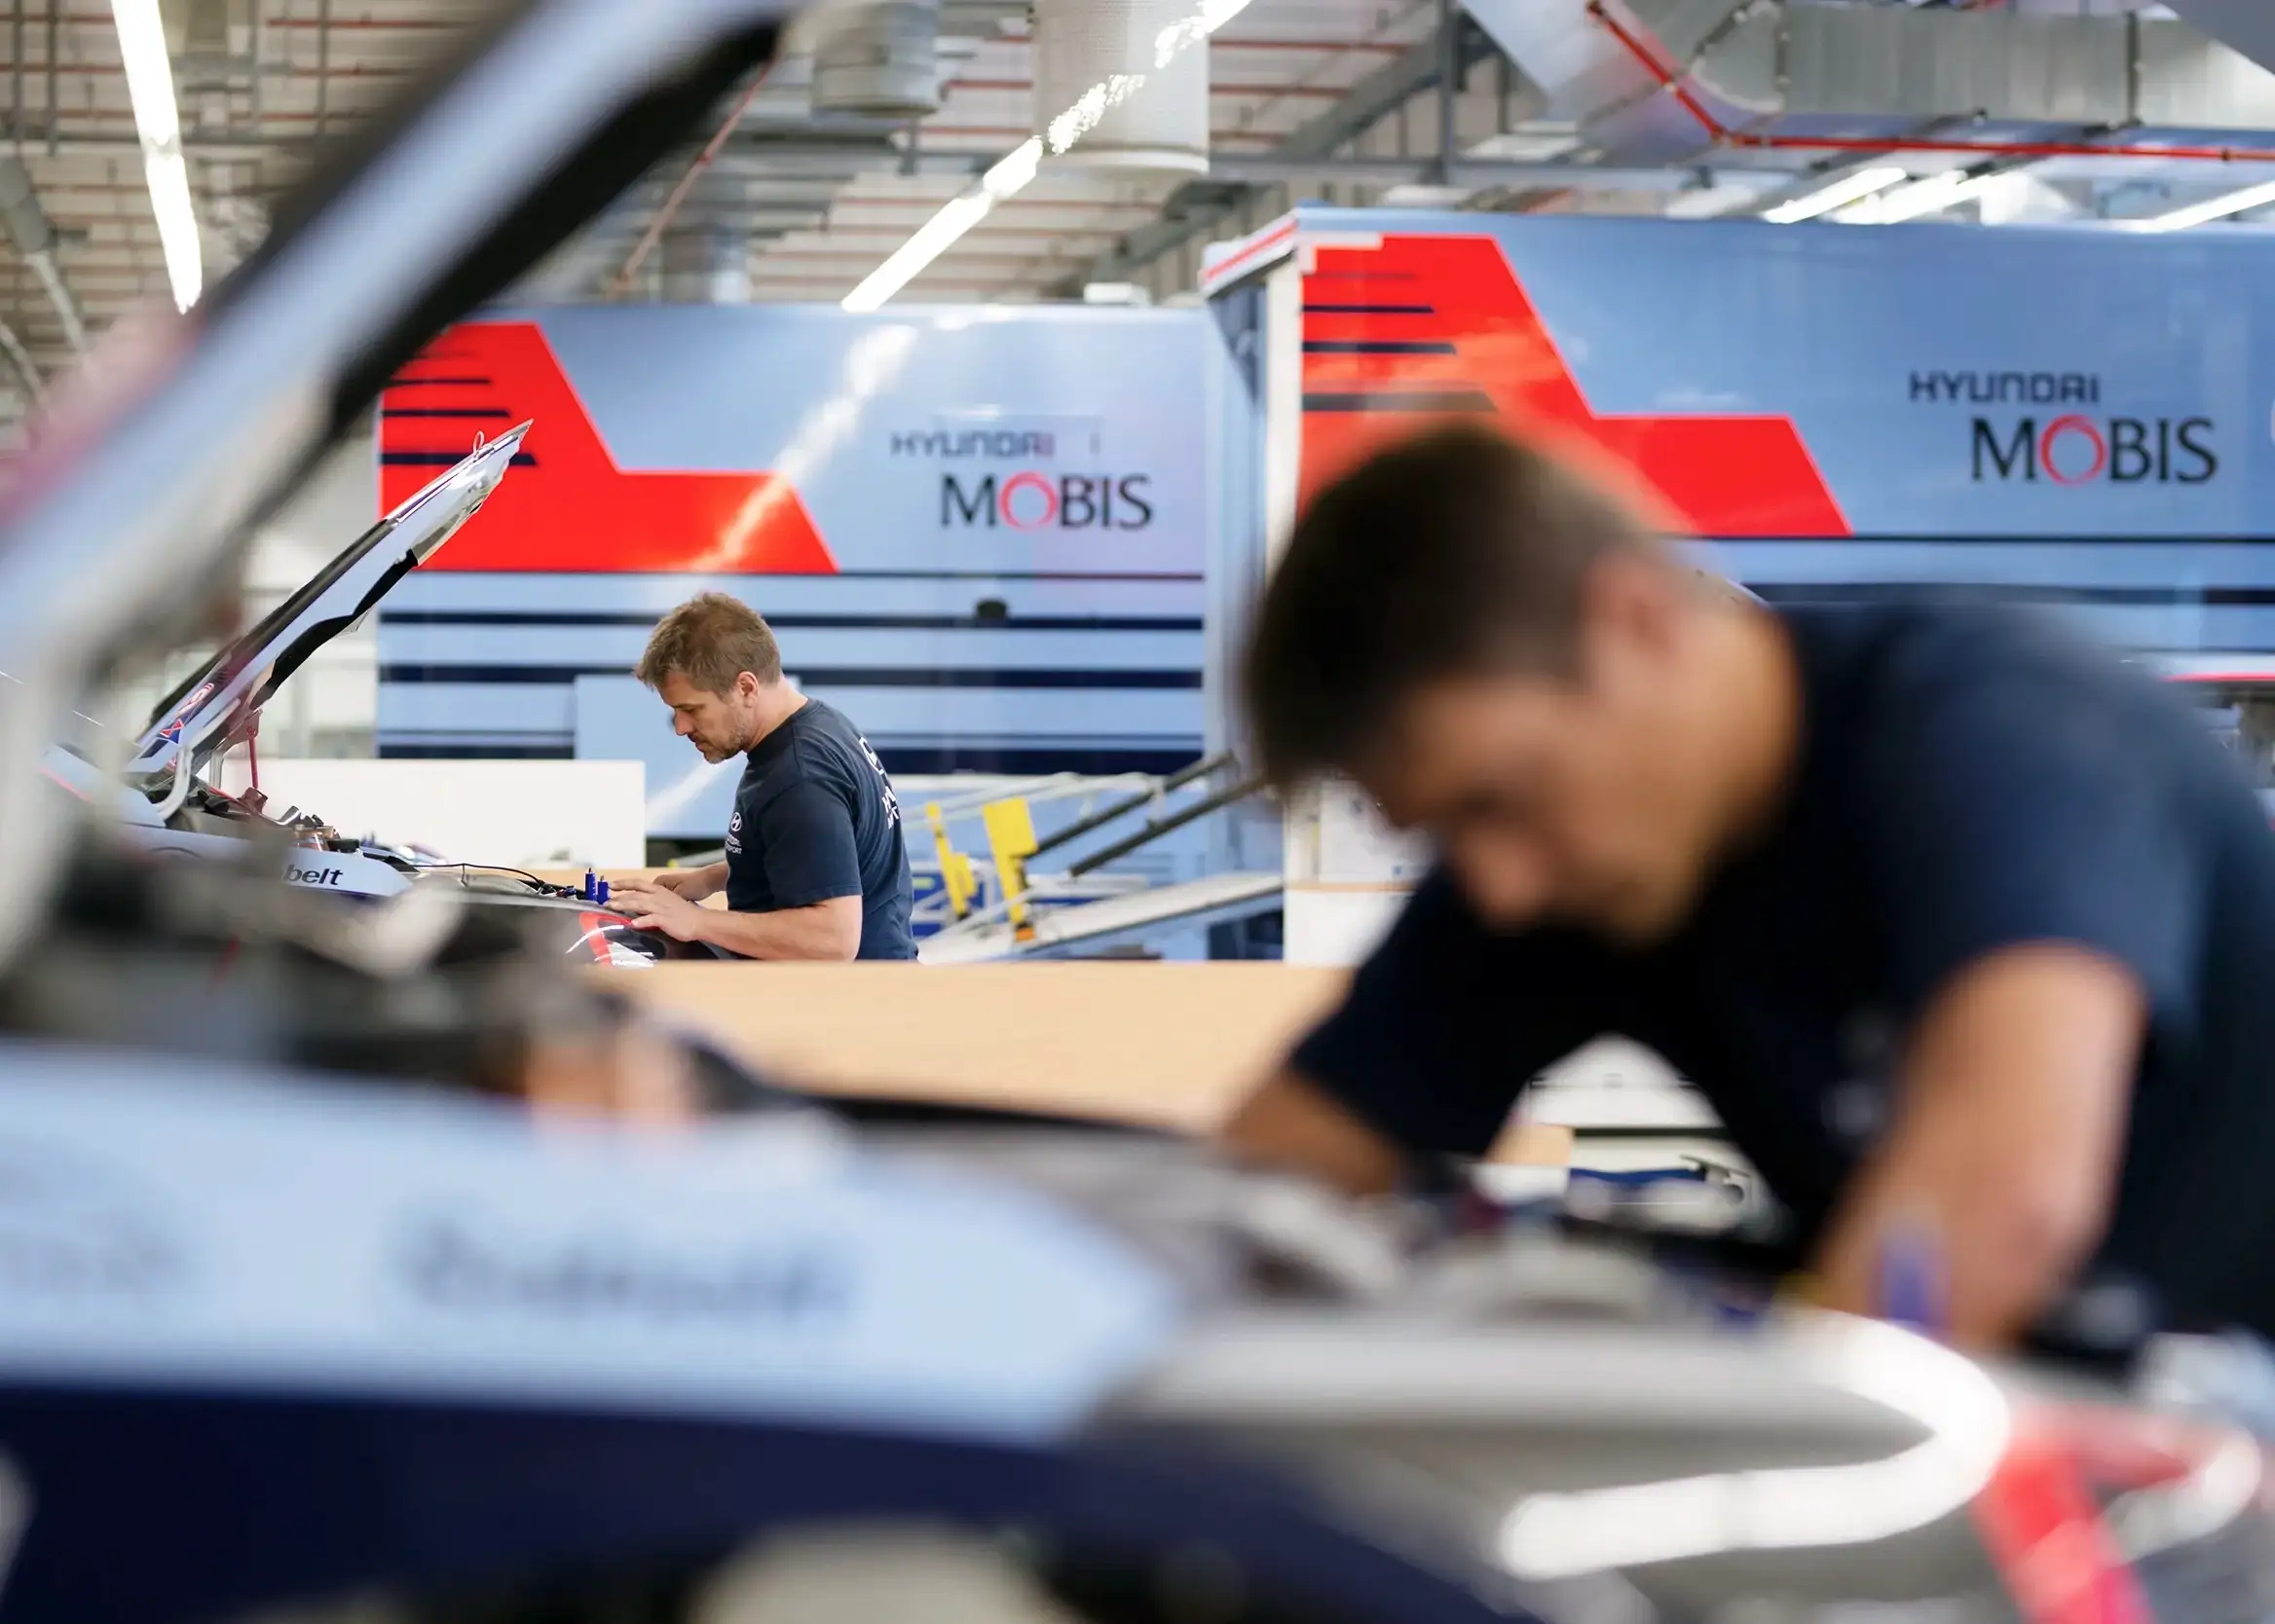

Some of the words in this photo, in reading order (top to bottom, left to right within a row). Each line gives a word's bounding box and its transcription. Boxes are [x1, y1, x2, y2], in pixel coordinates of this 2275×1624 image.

[1909, 372, 2100, 403] HYUNDAI
[1971, 414, 2219, 487] MOBIS
[941, 470, 1155, 532] MOBIS
[283, 865, 343, 886] belt
